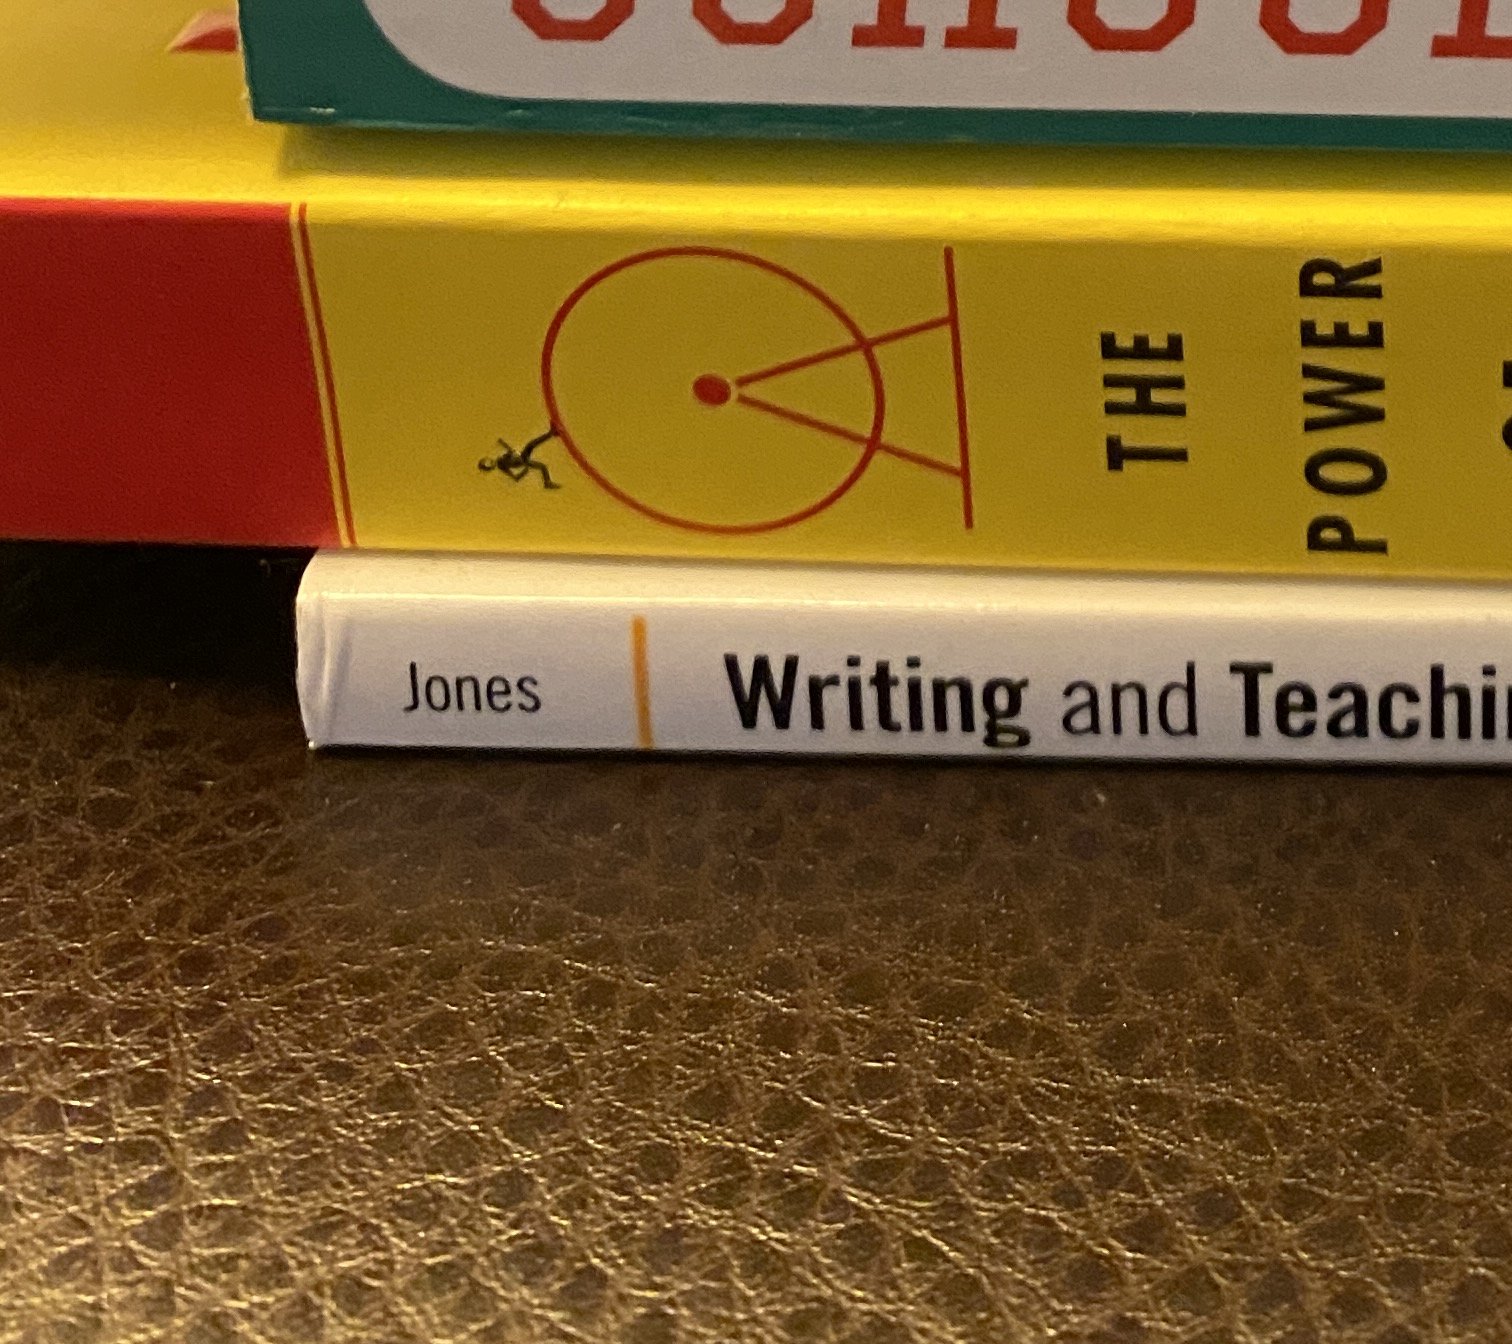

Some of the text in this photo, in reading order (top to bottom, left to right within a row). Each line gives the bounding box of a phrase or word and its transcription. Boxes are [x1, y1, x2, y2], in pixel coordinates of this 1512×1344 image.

[1100, 331, 1189, 472] THE
[1298, 256, 1388, 555] POWER
[403, 661, 542, 714] Jones
[723, 653, 1031, 749] Writing
[1061, 661, 1199, 738] and
